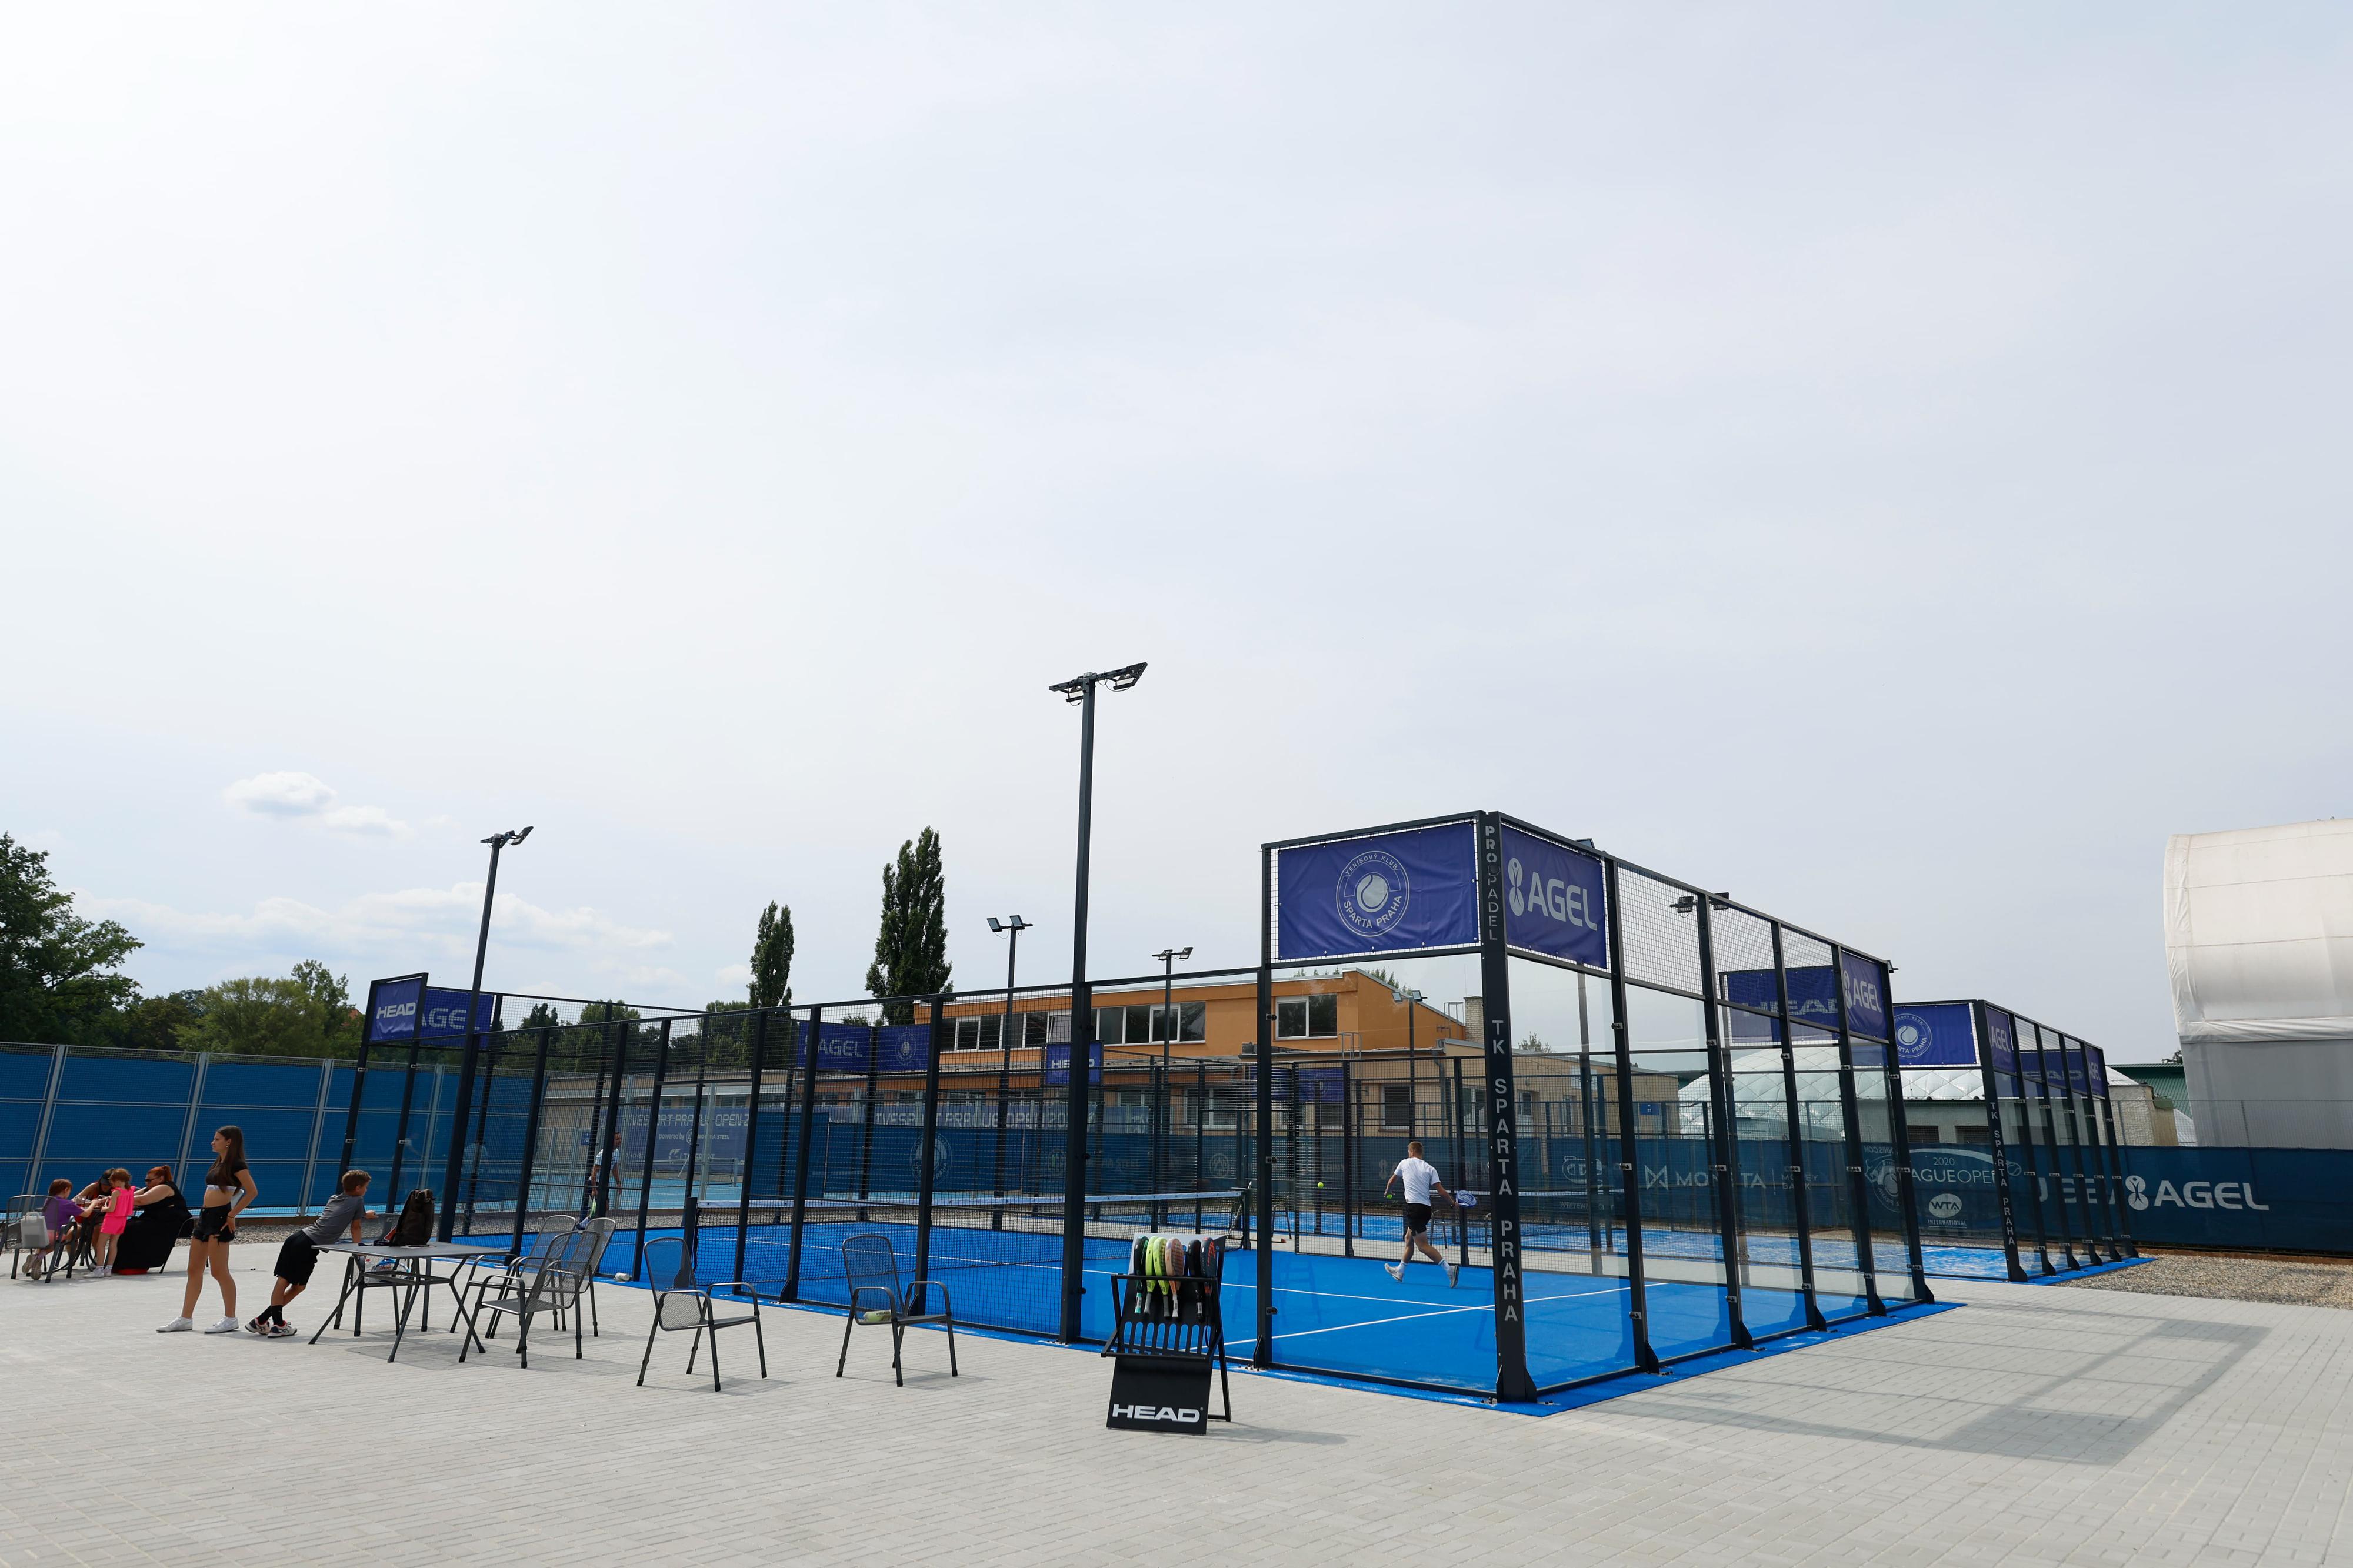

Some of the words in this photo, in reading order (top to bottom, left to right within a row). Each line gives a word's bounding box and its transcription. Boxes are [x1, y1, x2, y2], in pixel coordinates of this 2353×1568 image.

[1345, 853, 1378, 875] TENISOVÝ
[1381, 856, 1398, 869] KLUB
[1344, 900, 1372, 928] SPARTA
[1376, 896, 1402, 927] PRAHA
[1528, 872, 1597, 931] AGEL
[1853, 978, 1882, 1013] AGEL
[376, 1002, 416, 1019] HEAD
[818, 1039, 862, 1057] AGEL
[1492, 1020, 1505, 1054] TK
[1911, 1037, 1927, 1053] PRAHA
[1991, 1026, 2011, 1053] AGEL
[1051, 1059, 1095, 1069] HED
[1495, 1078, 1512, 1195] SPARTA
[1932, 1157, 1955, 1166] 2020
[1990, 1102, 1998, 1120] TK
[1994, 1130, 2007, 1186] SPARTA
[2003, 1198, 2015, 1245] PRAHA
[1676, 1171, 1766, 1189] MOTA
[1931, 1201, 1960, 1210] WTA
[2154, 1180, 2269, 1210] AGEL
[1501, 1220, 1518, 1321] PRAHA
[1112, 1404, 1200, 1423] HEAD
